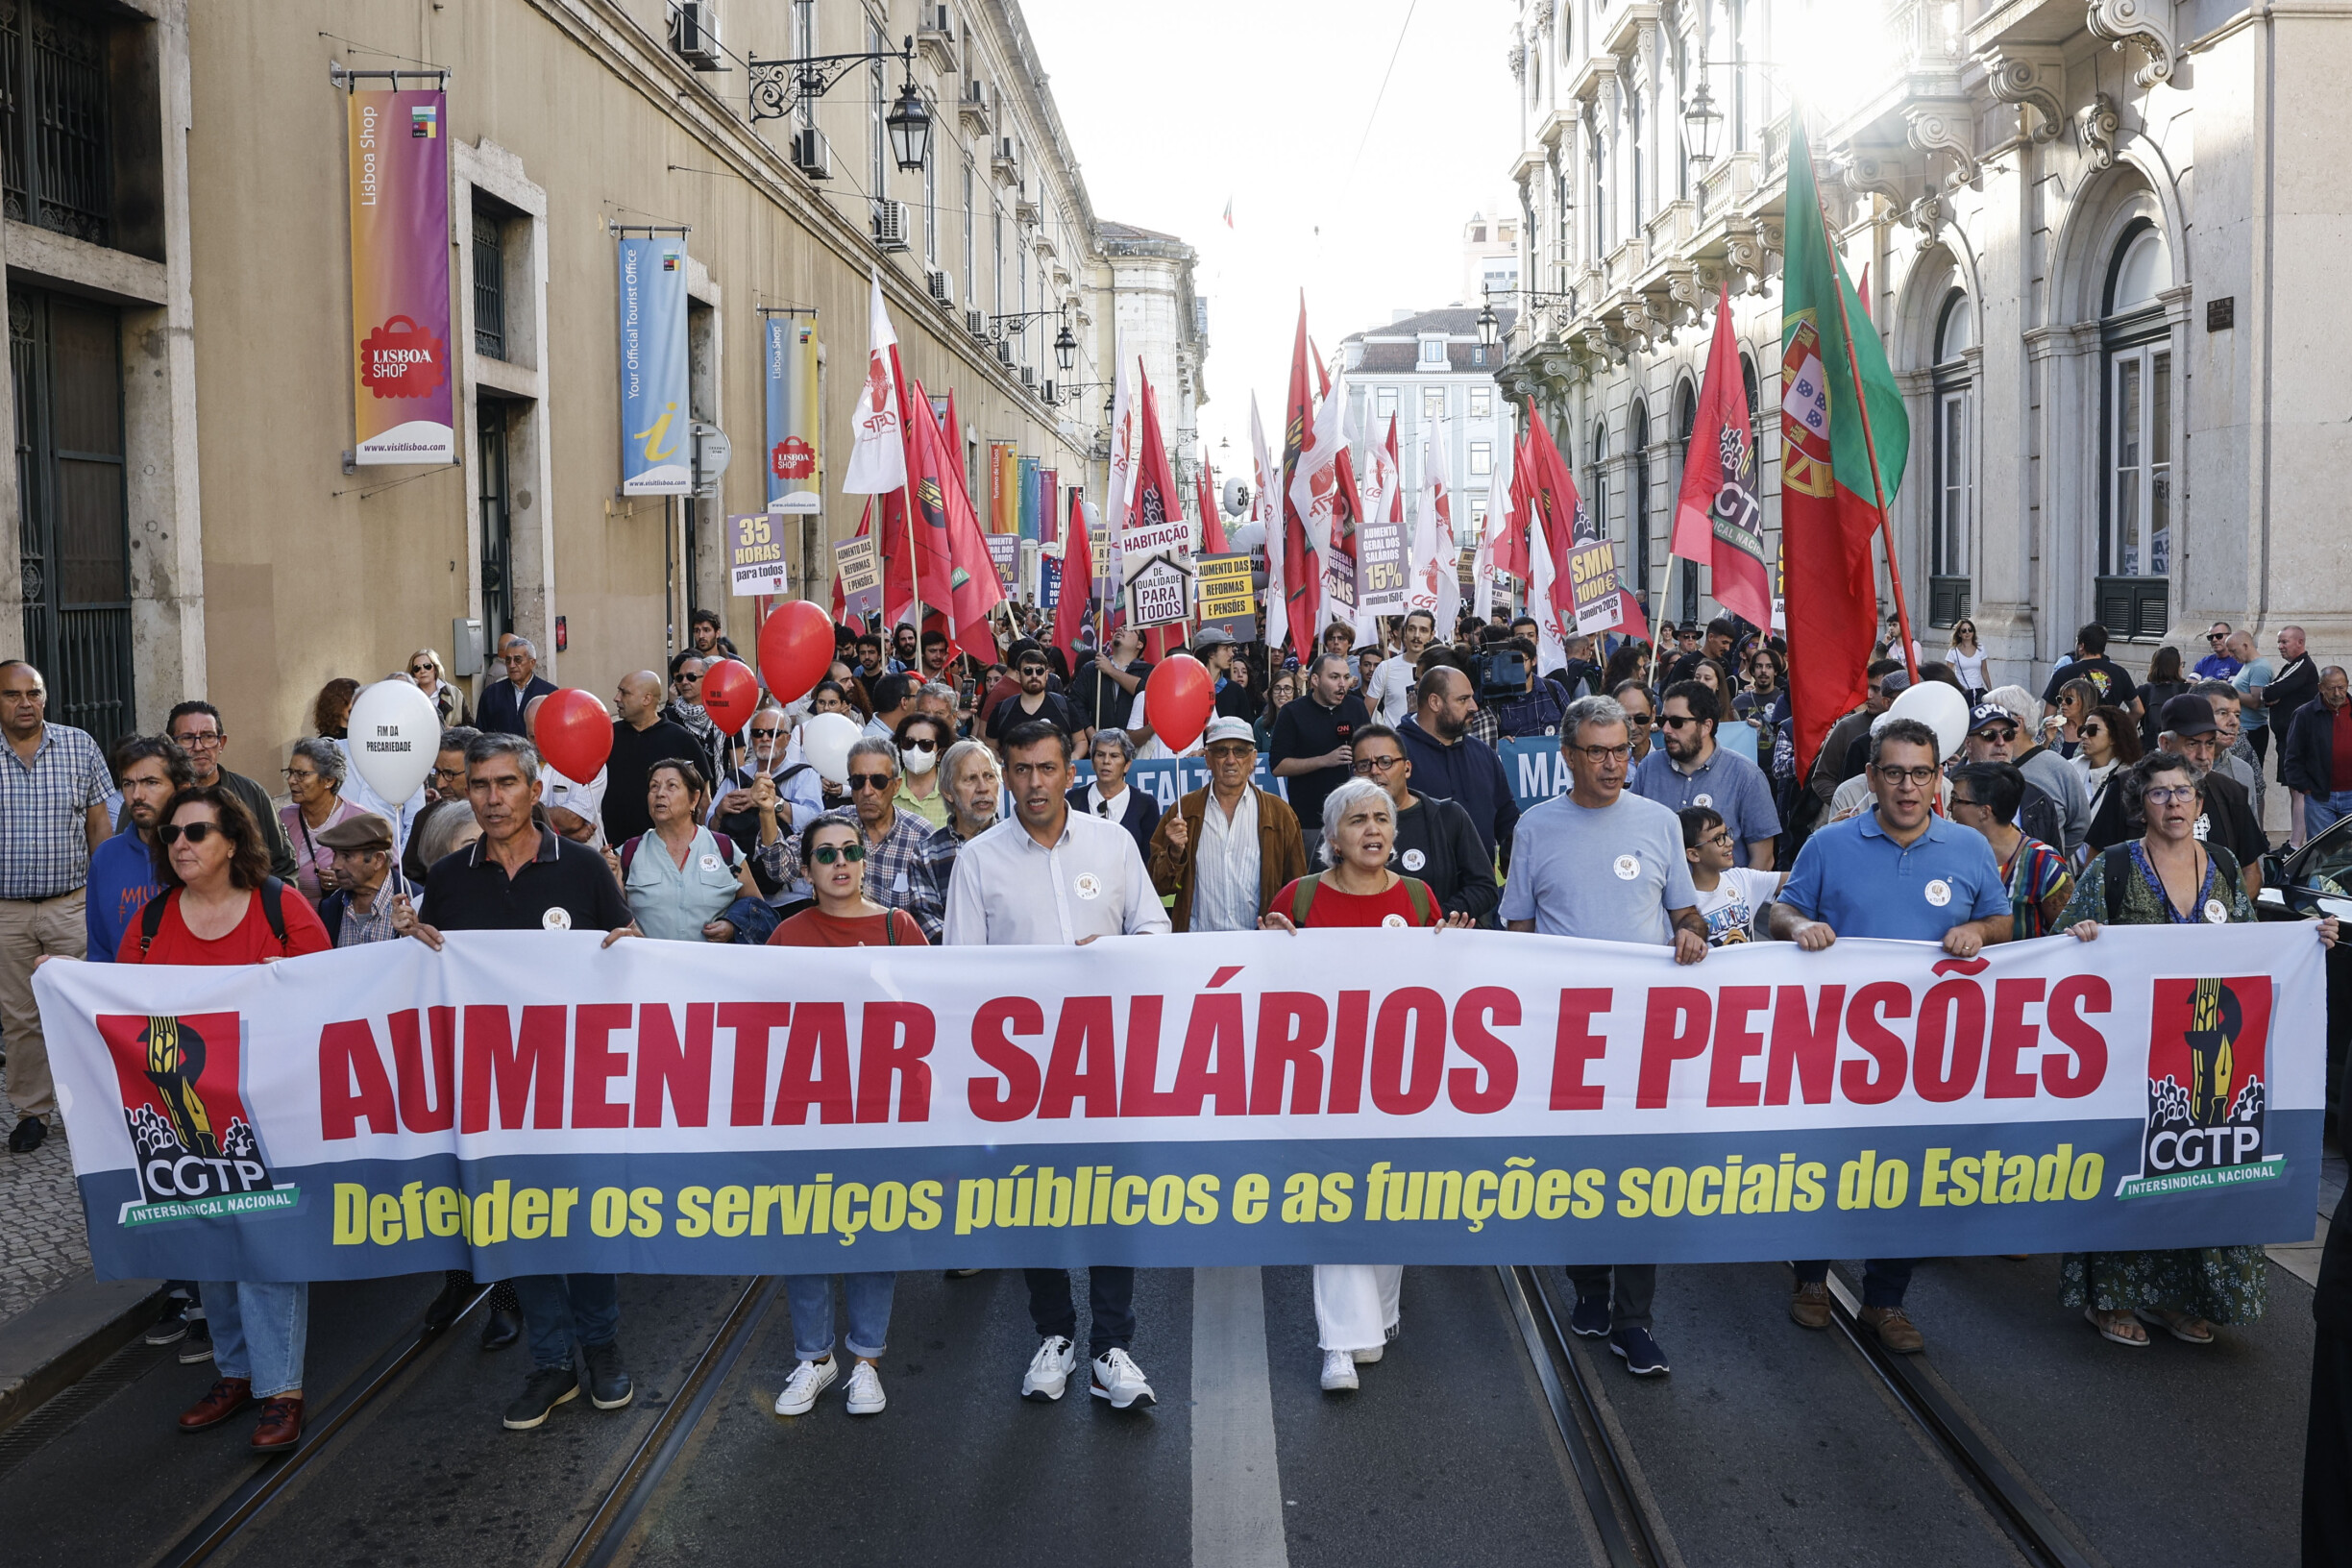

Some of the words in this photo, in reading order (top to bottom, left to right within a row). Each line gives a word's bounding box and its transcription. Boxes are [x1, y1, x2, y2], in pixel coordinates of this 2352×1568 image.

[359, 106, 378, 149] Shop
[361, 153, 376, 206] Lisboa
[625, 249, 637, 284] Office
[626, 286, 638, 327] Tourist
[772, 326, 782, 347] Shop
[373, 349, 432, 363] LISBOA
[626, 329, 639, 370] Official
[373, 363, 407, 378] SHOP
[772, 348, 781, 380] Lisboa
[627, 372, 640, 400] Your
[364, 442, 446, 453] www.visitlisboa.com
[778, 453, 809, 461] LISBOA
[777, 460, 797, 469] SHOP
[739, 516, 772, 546] 35
[1124, 525, 1188, 552] HABITAÇÃO
[1364, 526, 1397, 539] AUMENTO
[735, 543, 781, 565] HORAS
[838, 544, 861, 560] AUMENTO
[861, 541, 871, 553] DAS
[1363, 538, 1384, 551] GERAL
[1385, 537, 1400, 549] DOS
[1365, 549, 1400, 563] SALÁRIOS
[1571, 543, 1614, 584] SMN
[736, 569, 757, 582] para
[758, 565, 783, 577] todos
[845, 558, 870, 576] REFORMAS
[1153, 567, 1164, 576] DE
[1199, 562, 1233, 576] AUMENTO
[1234, 560, 1249, 573] DAS
[1365, 562, 1403, 591] 15%
[847, 582, 851, 591] E
[852, 575, 874, 591] PENSÕES
[1137, 575, 1181, 589] QUALIDADE
[1206, 580, 1244, 596] REFORMAS
[1330, 575, 1354, 605] SNS
[1576, 574, 1616, 603] 1000€
[1142, 586, 1177, 604] PARA
[1139, 600, 1181, 621] TODOS
[1208, 604, 1213, 616] E
[1213, 600, 1245, 615] PENSÕES
[1579, 603, 1603, 621] Janeiro
[1602, 596, 1619, 612] 2025
[377, 725, 388, 737] FIM
[389, 725, 399, 736] DA
[1336, 724, 1350, 733] CNN
[366, 741, 412, 752] PRECARIEDADE
[318, 1001, 937, 1141] AUMENTAR
[967, 966, 1523, 1122] SALÁRIOS
[1549, 988, 1613, 1111] E
[1635, 957, 2112, 1110] PENSÕES
[2149, 1126, 2261, 1170] CGTP
[146, 1155, 265, 1196] CGTP
[2128, 1173, 2214, 1195] INTERSINDICAL
[2217, 1165, 2276, 1184] NACIONAL
[332, 1179, 578, 1247] Defender
[591, 1186, 662, 1237] os
[675, 1173, 943, 1246] serviços
[954, 1164, 1220, 1235] públicos
[1232, 1173, 1270, 1223] e
[1282, 1172, 1353, 1223] as
[1364, 1156, 1605, 1233] funções
[1616, 1153, 1826, 1218] sociais
[1836, 1150, 1909, 1211] do
[1919, 1143, 2105, 1208] Estado
[133, 1204, 223, 1222] INTERSINDICAL
[227, 1193, 291, 1211] NACIONAL
